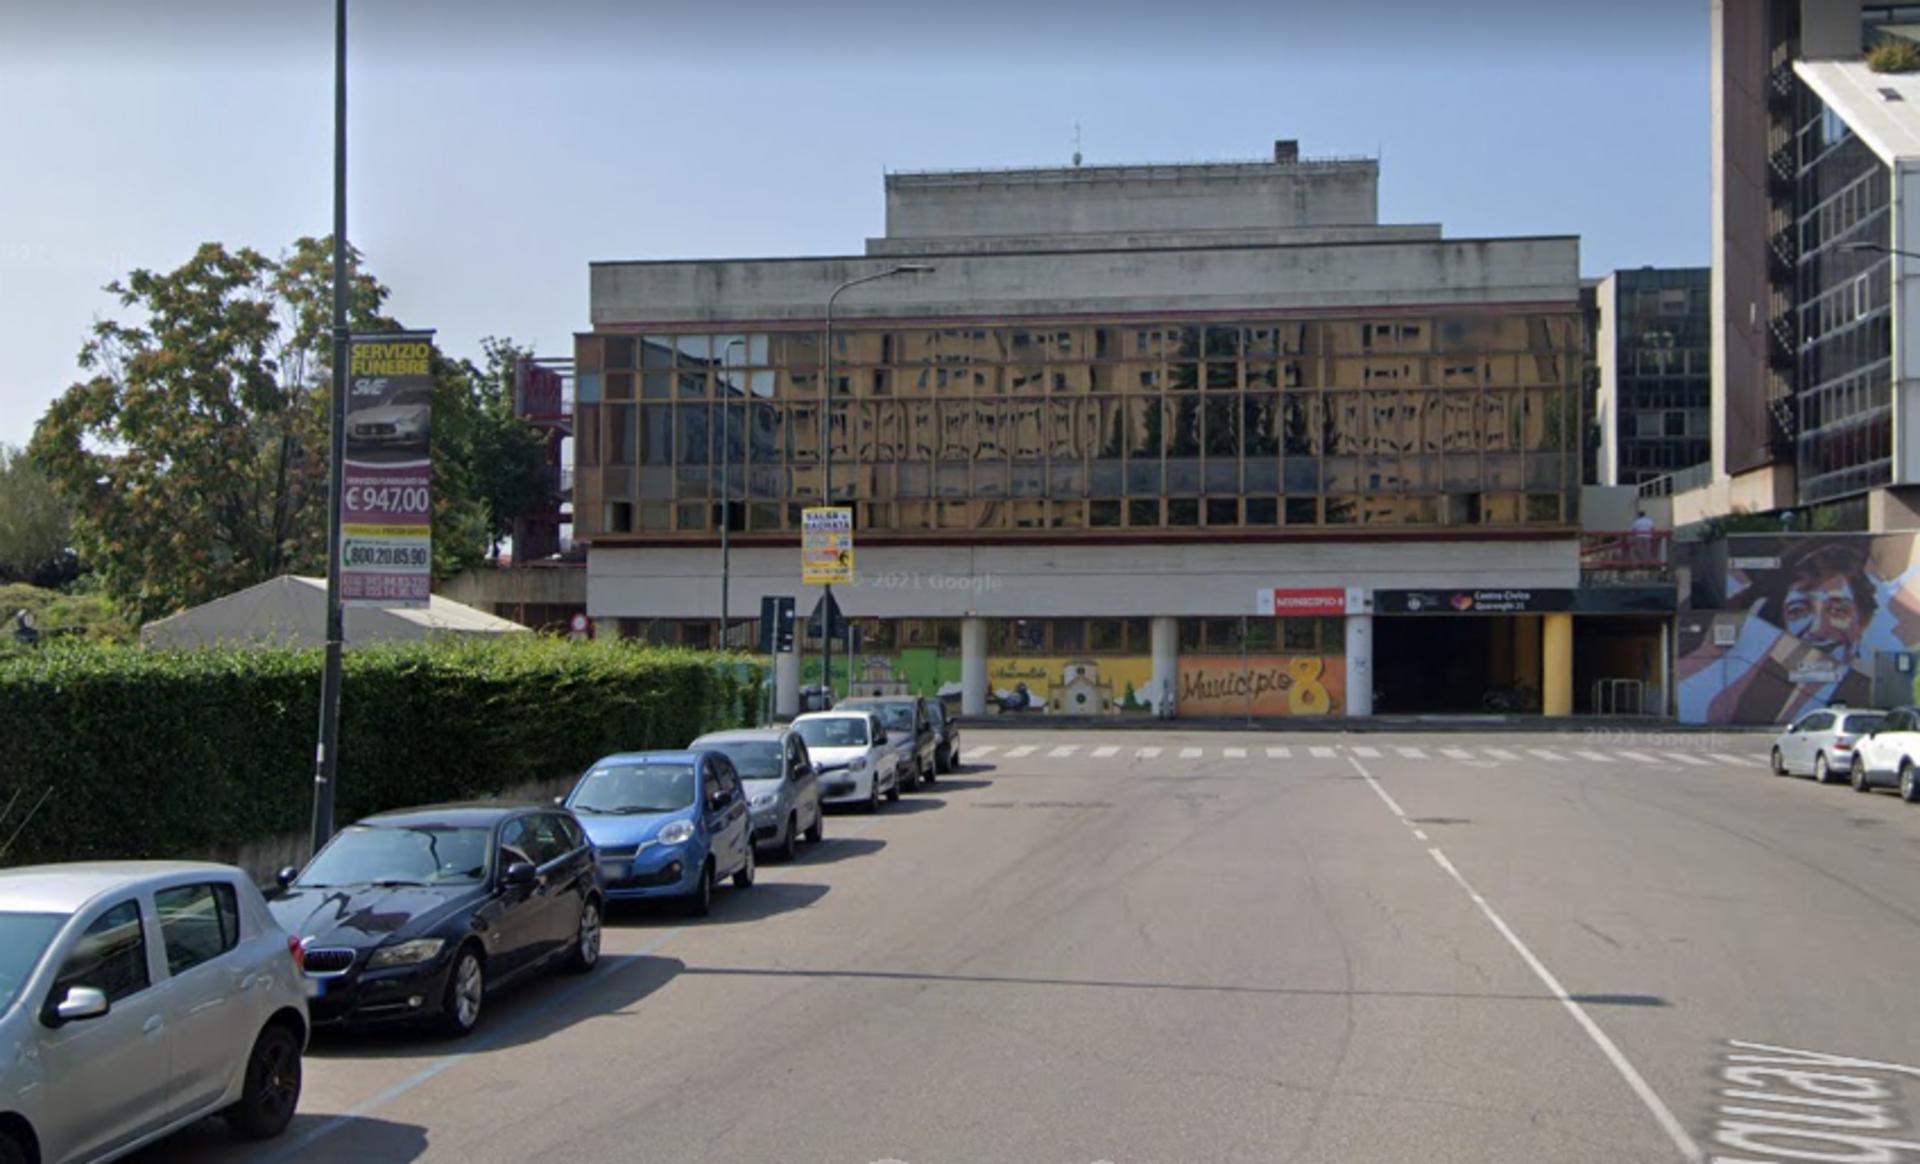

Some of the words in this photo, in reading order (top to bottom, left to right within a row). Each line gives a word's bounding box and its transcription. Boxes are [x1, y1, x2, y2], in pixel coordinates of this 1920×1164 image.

[351, 343, 429, 359] SERVIZIO
[351, 359, 429, 376] FUNEBRE
[1182, 669, 1293, 700] Municipio
[1289, 656, 1332, 715] 8
